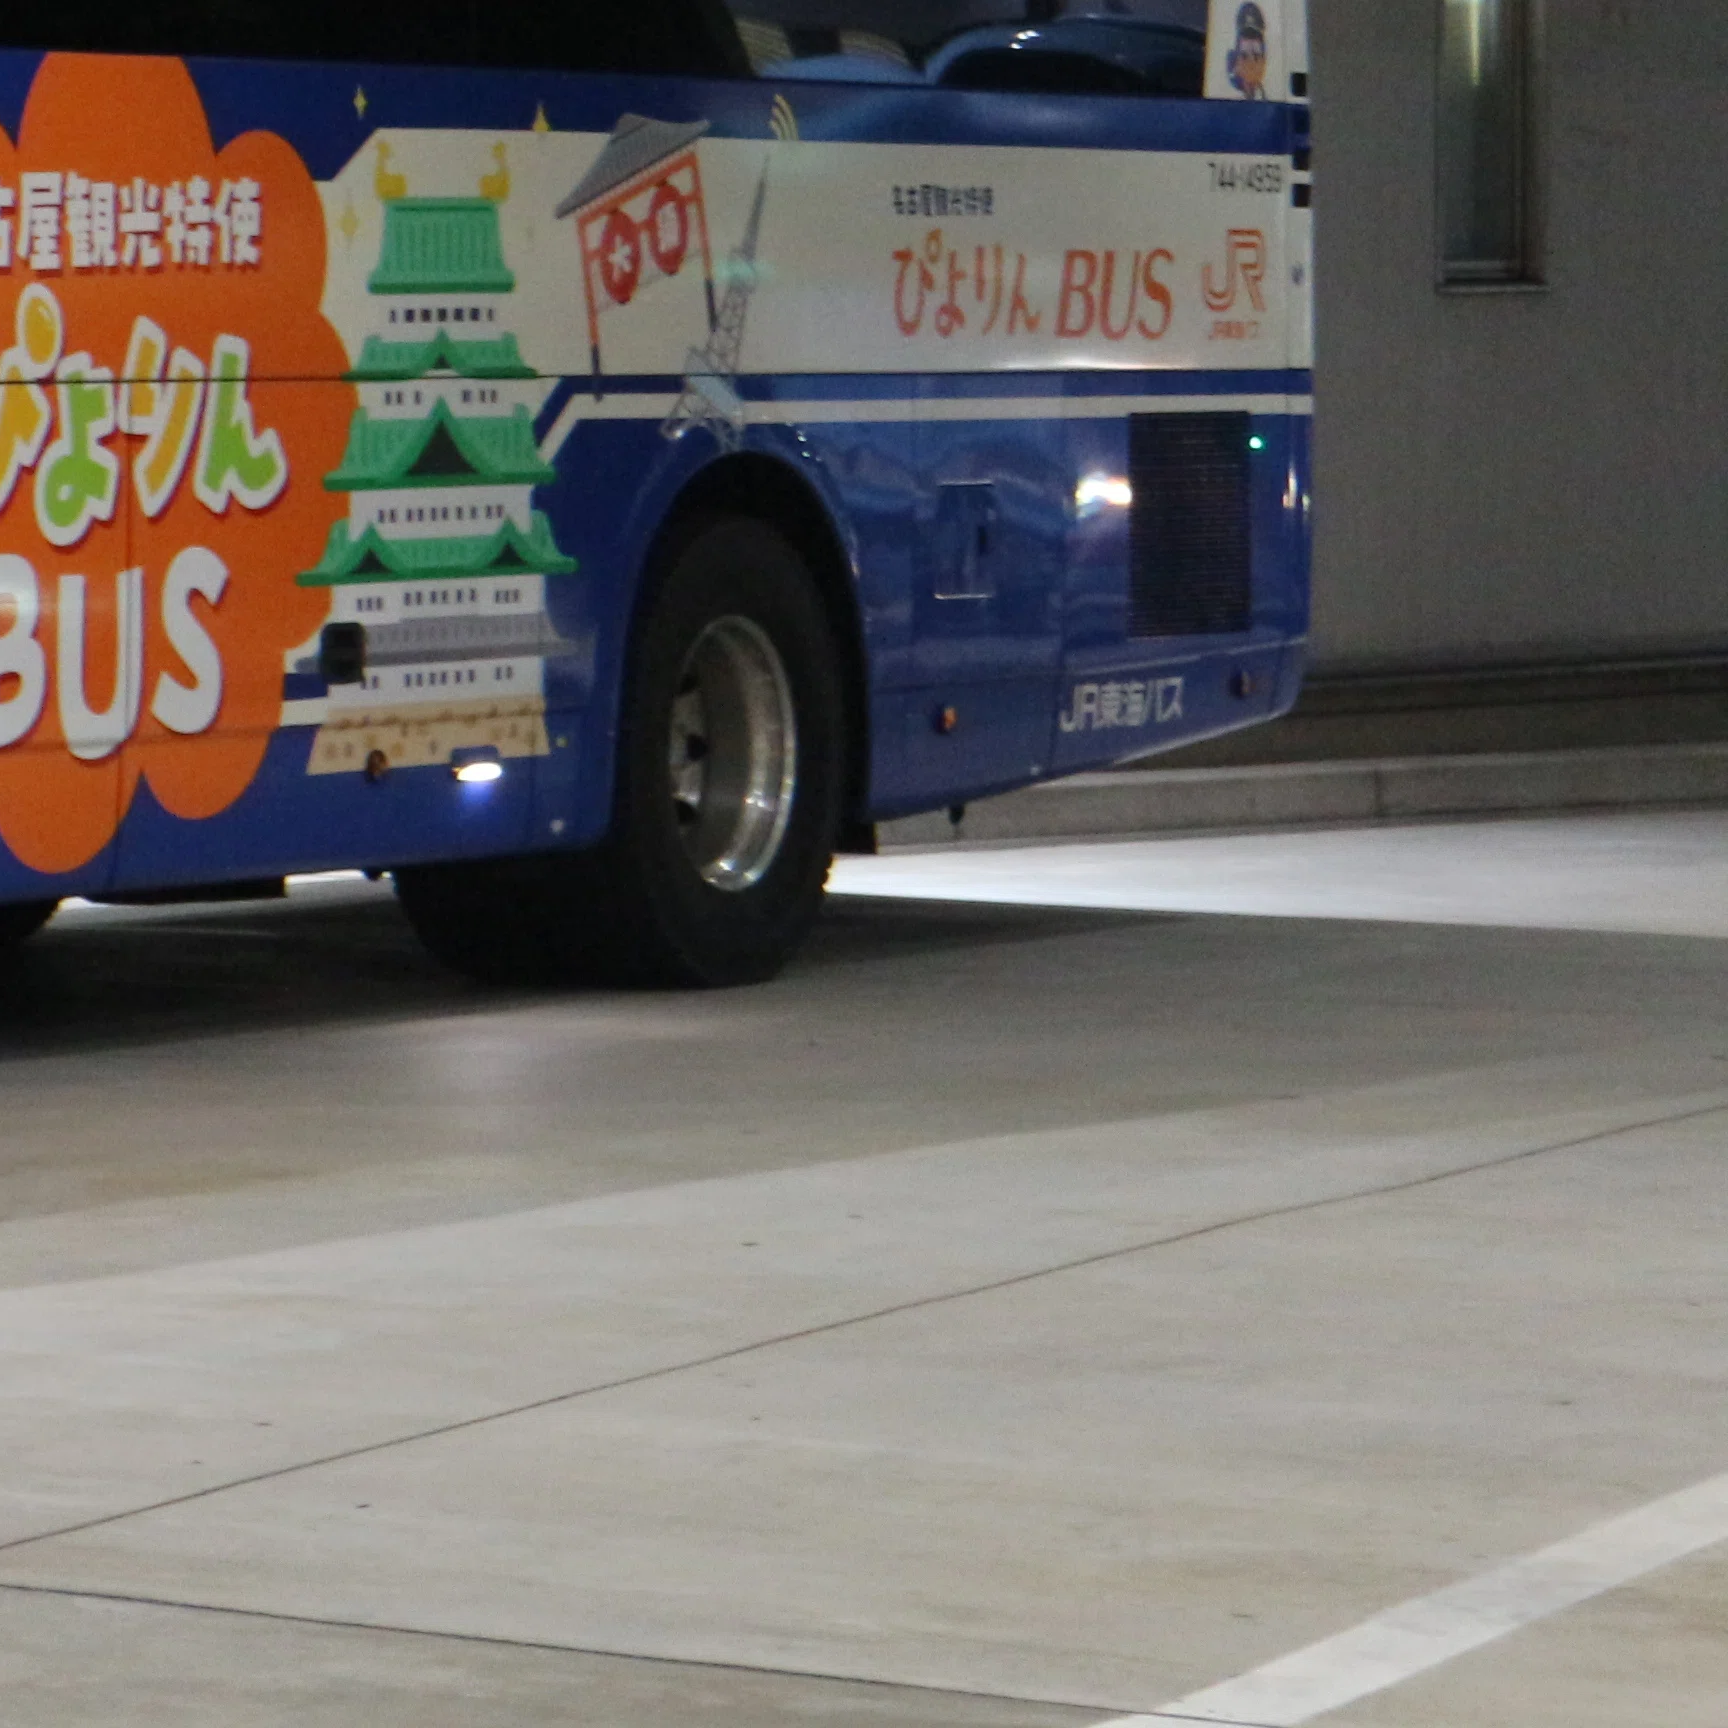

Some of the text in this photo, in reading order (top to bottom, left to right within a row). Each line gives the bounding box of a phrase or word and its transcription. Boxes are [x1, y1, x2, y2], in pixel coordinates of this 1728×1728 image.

[1201, 228, 1267, 313] JR
[1059, 676, 1184, 733] JR東海バス
